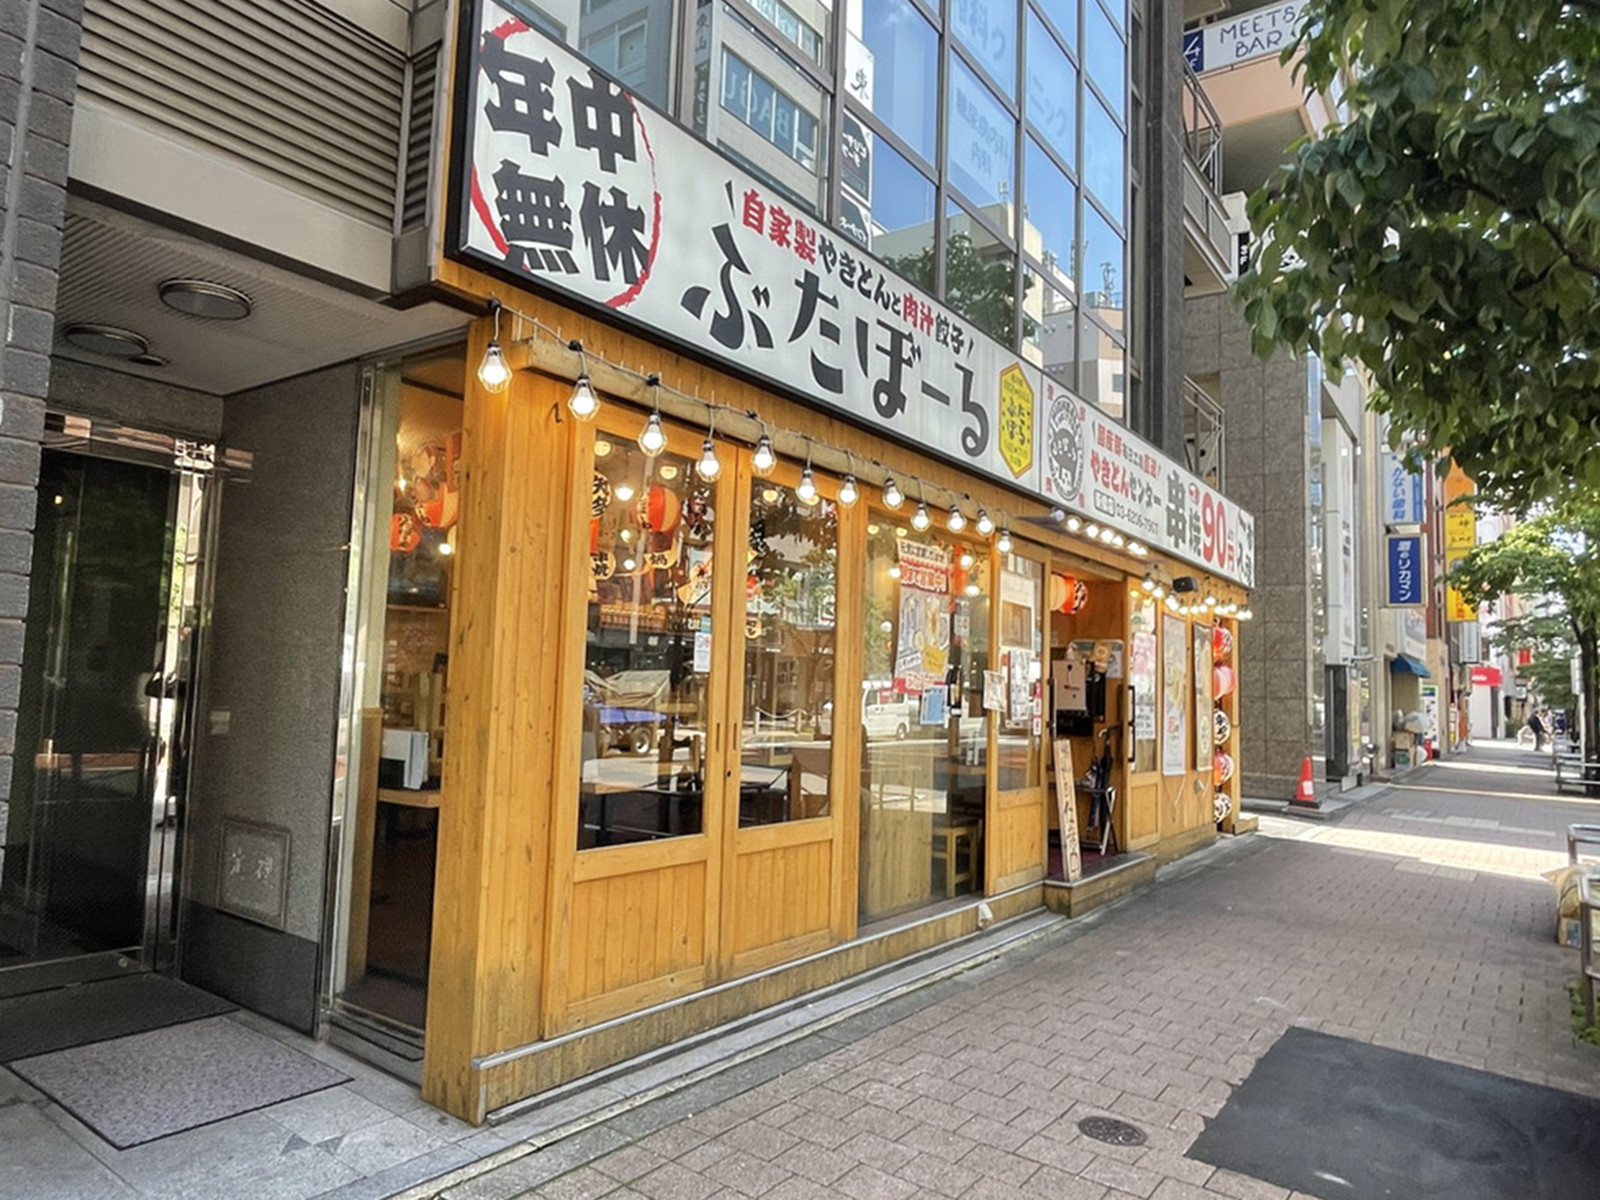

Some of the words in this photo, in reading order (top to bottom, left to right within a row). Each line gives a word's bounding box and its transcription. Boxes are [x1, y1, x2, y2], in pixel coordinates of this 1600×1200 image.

[1220, 6, 1296, 44] MEETS
[1235, 30, 1282, 58] BAR
[480, 31, 637, 174] 年中
[492, 159, 646, 285] 無休
[682, 223, 989, 457] ぶたぼーる
[1090, 449, 1162, 508] やきとんセンター
